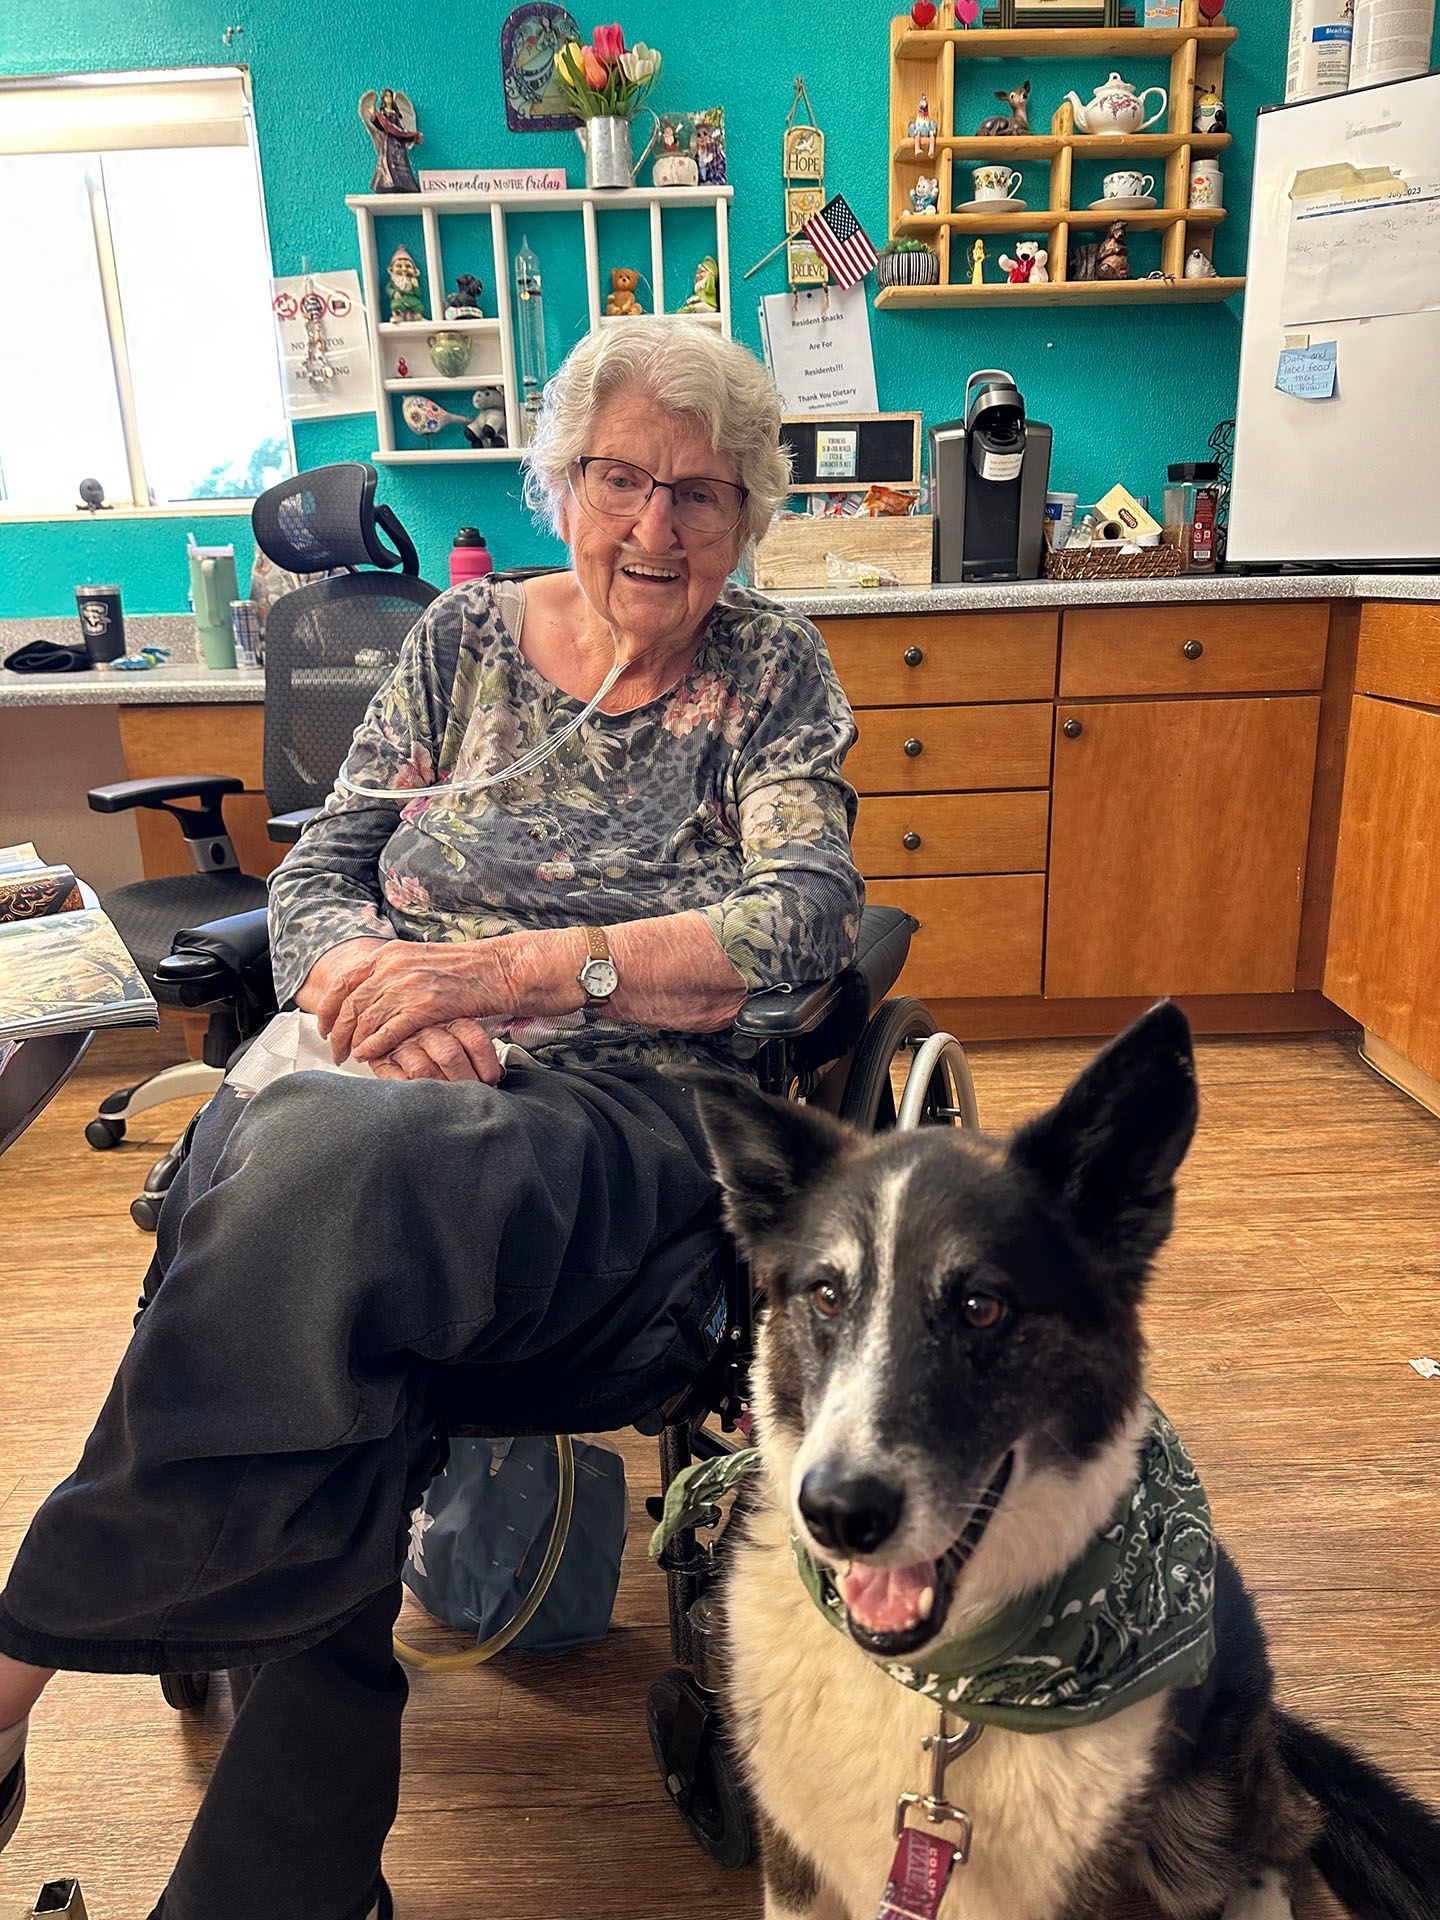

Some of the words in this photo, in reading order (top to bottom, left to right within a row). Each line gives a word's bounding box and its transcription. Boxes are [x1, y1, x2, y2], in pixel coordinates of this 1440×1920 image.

[788, 154, 819, 172] HOPE
[422, 180, 447, 191] LESS
[526, 173, 560, 190] friday
[1388, 191, 1403, 199] July
[1403, 187, 1421, 196] 023
[792, 263, 824, 277] BELIEVE
[791, 317, 820, 327] Resident
[821, 313, 844, 323] Snacks
[290, 342, 305, 350] NO
[804, 364, 844, 376] Residents!!!
[1309, 361, 1331, 371] food
[798, 394, 819, 402] Thank
[819, 392, 831, 400] You
[832, 388, 856, 398] Dietary
